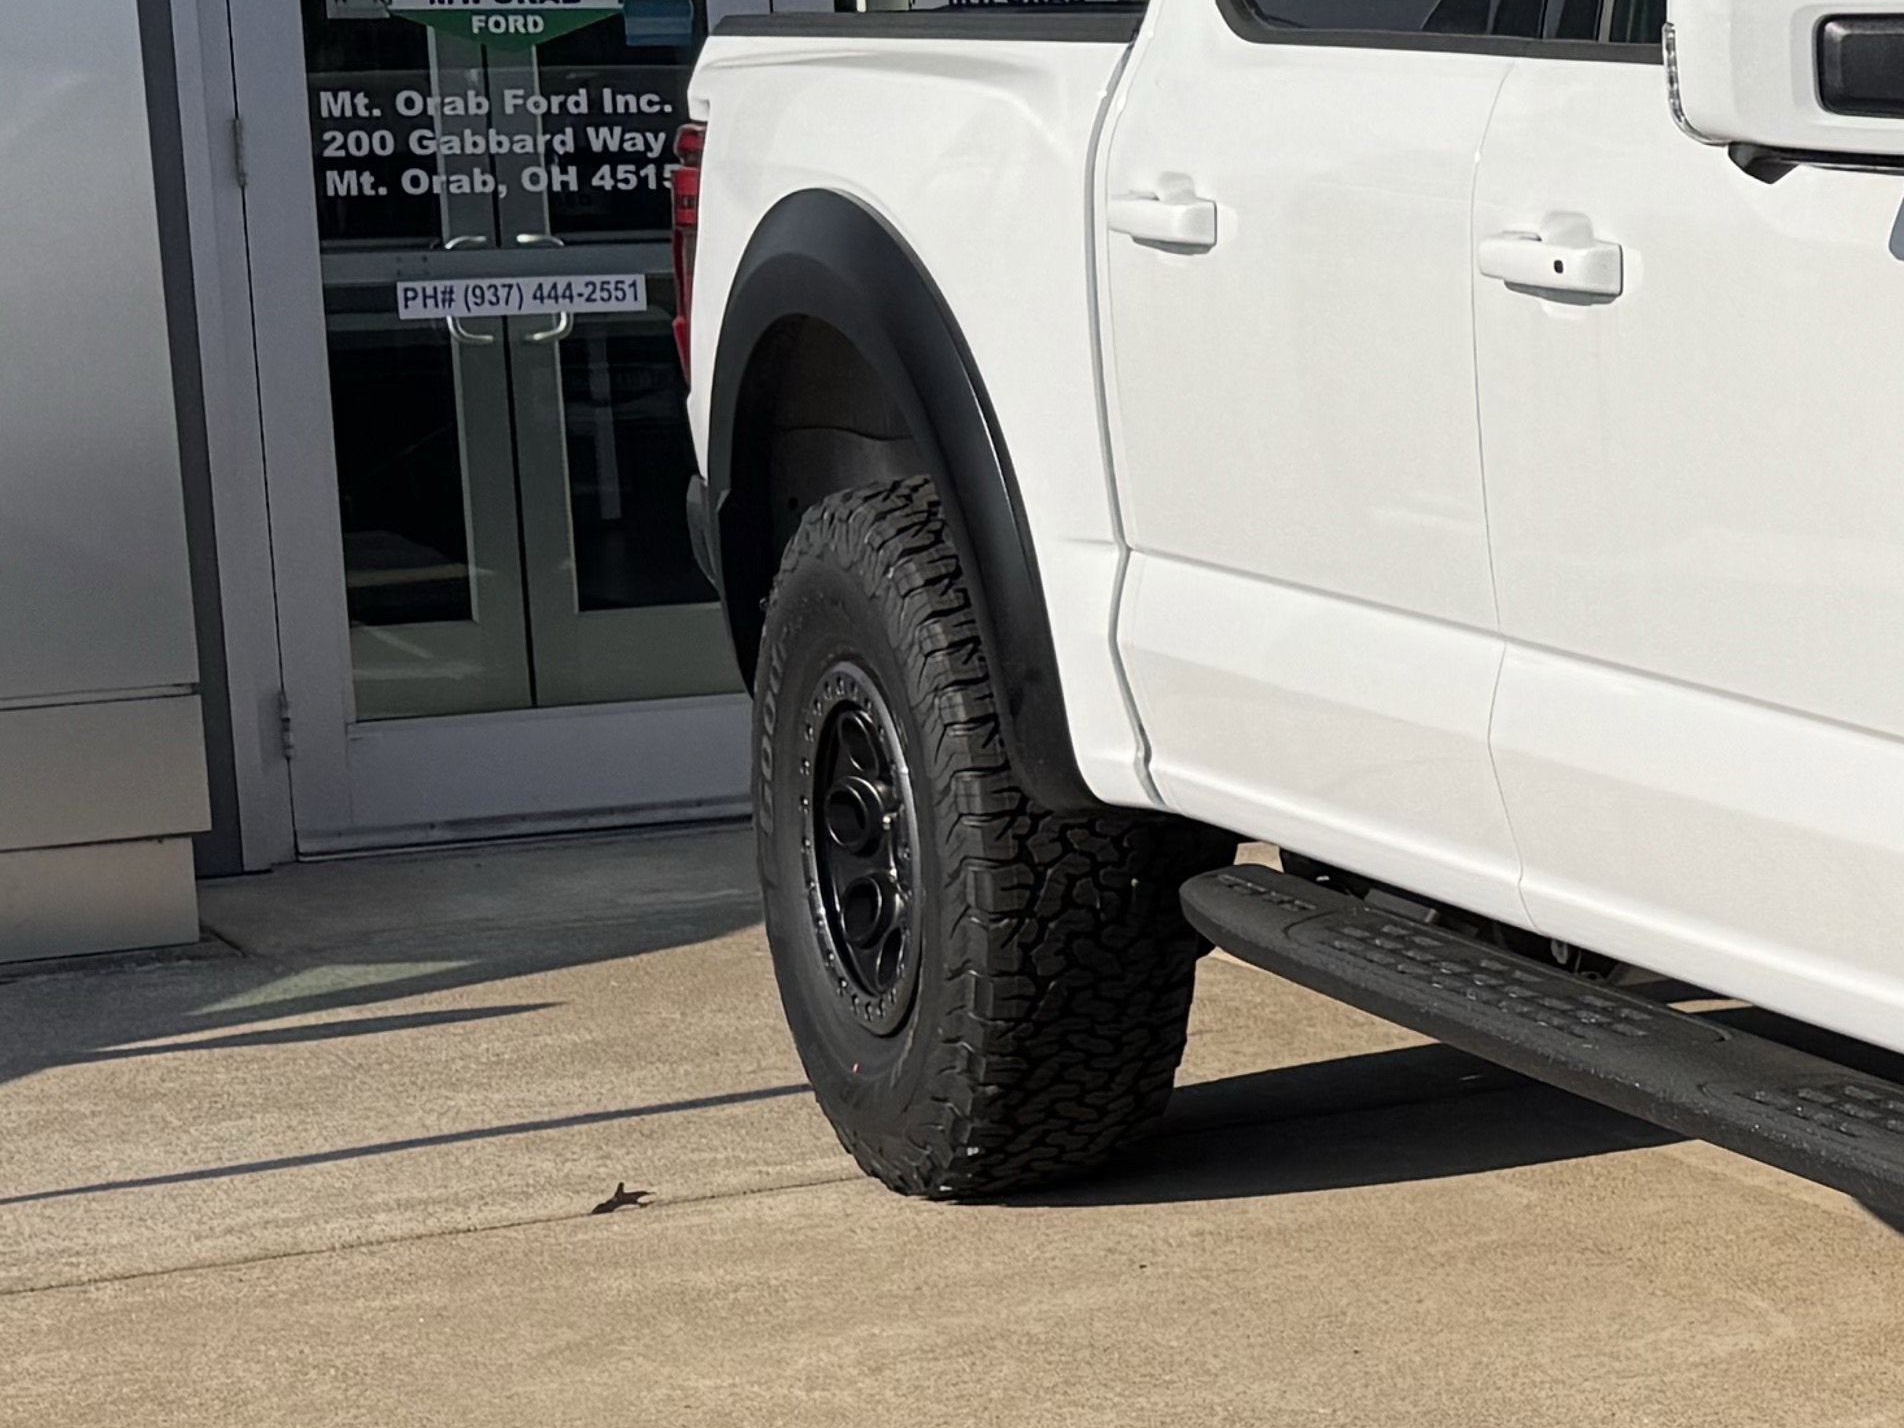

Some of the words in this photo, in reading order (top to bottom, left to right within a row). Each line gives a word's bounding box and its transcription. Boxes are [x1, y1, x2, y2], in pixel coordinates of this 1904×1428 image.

[471, 14, 545, 35] FORD
[320, 90, 382, 118] Mt.
[395, 89, 490, 116] Orab
[503, 88, 588, 115] Ford
[602, 87, 673, 114] Inc.
[322, 129, 395, 157] 200
[408, 127, 575, 156] Gabbard
[586, 125, 666, 159] Way
[326, 169, 388, 197] Mt.
[401, 167, 507, 198] Orab,
[521, 164, 579, 192] OH
[591, 163, 682, 191] 4515
[402, 284, 456, 310] PH#
[463, 282, 524, 313] (937)
[531, 279, 640, 305] 444-2551
